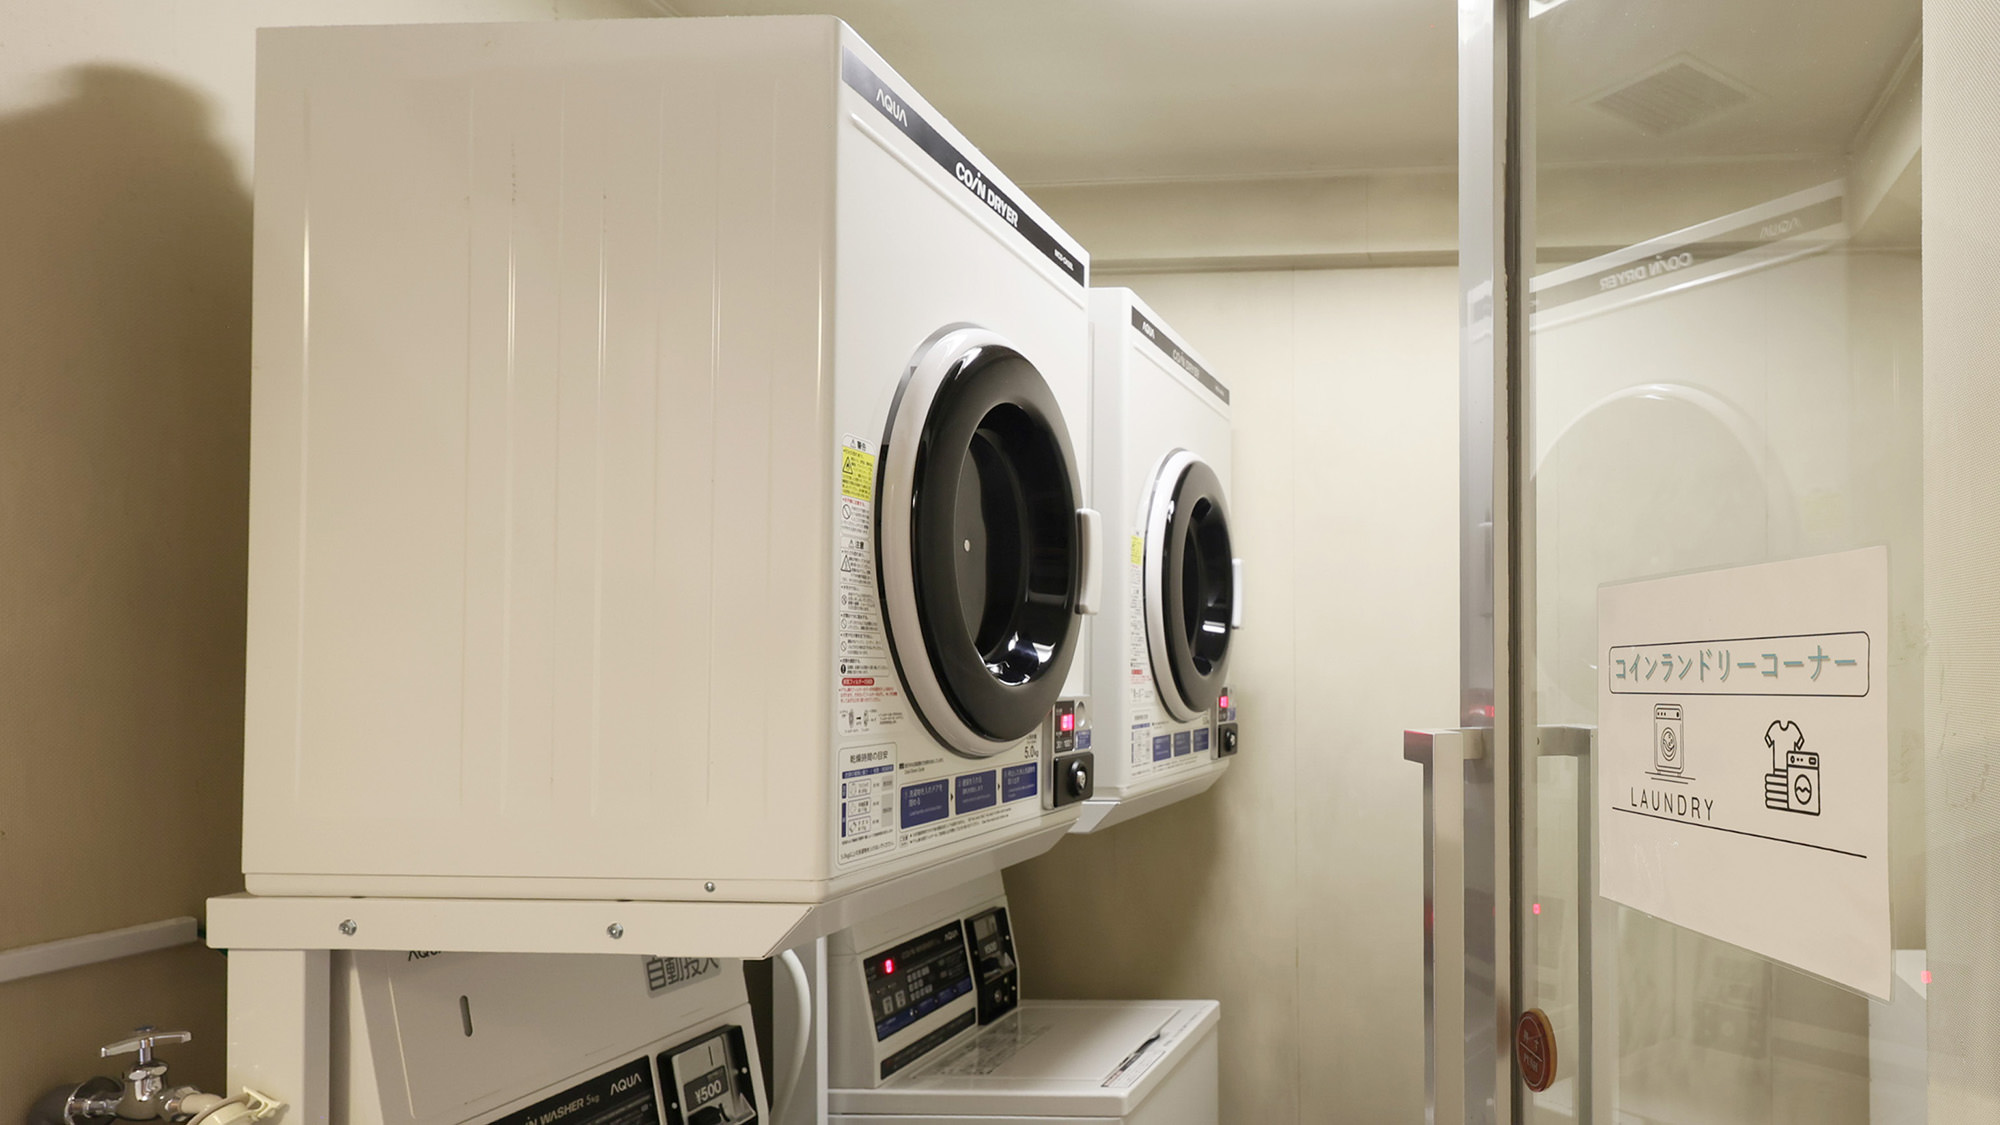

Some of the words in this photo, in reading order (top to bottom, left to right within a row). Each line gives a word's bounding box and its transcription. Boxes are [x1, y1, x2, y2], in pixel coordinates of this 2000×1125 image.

[876, 88, 908, 127] AQUA
[987, 188, 1019, 227] DRYER
[1615, 645, 1858, 682] コインランドリーコーナー
[1630, 786, 1714, 821] LAUNDRY
[610, 1072, 642, 1096] AQUA
[694, 1079, 722, 1105] ¥500
[540, 1097, 585, 1125] WASHER
